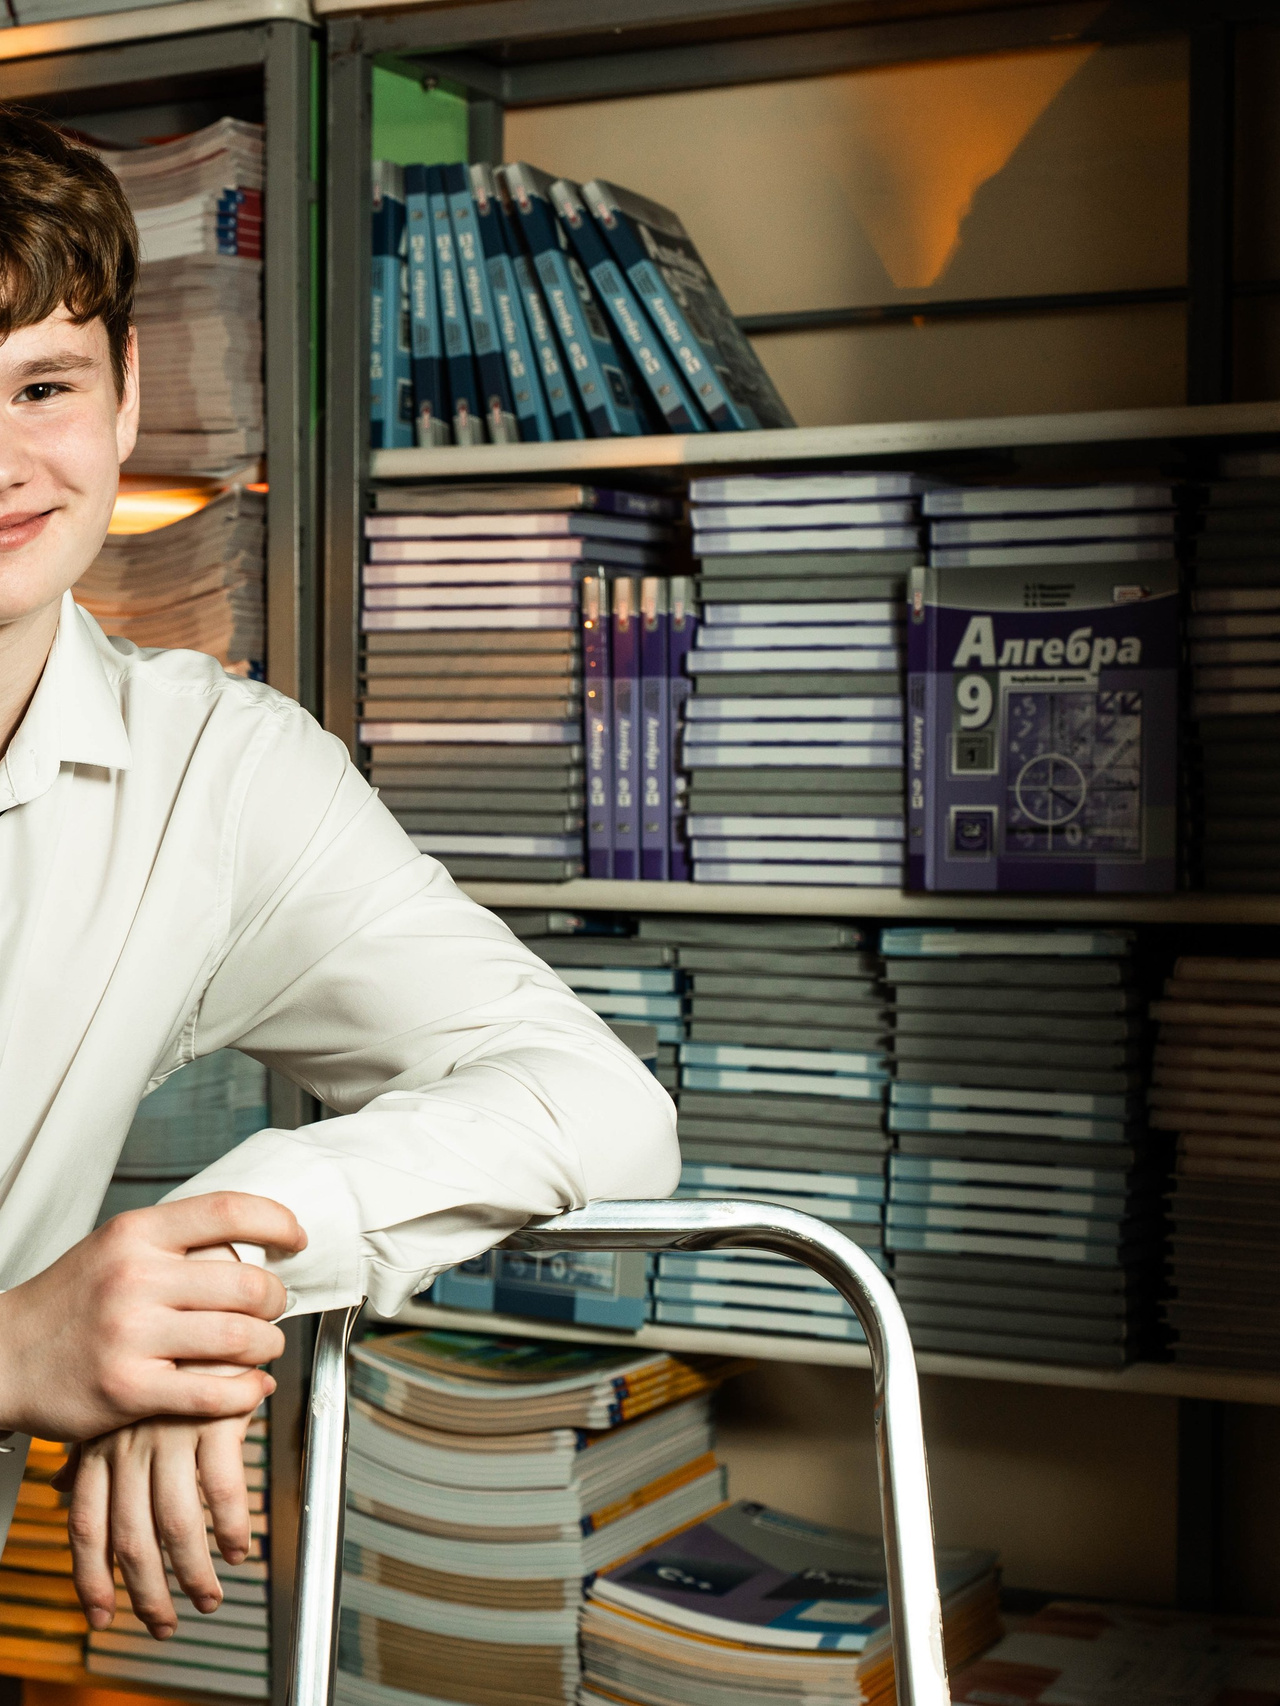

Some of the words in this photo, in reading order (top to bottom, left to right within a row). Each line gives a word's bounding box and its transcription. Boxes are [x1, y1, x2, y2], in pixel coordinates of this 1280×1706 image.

[952, 616, 1142, 676] Алгебра
[957, 674, 993, 729] 9
[656, 1566, 713, 1590] C++
